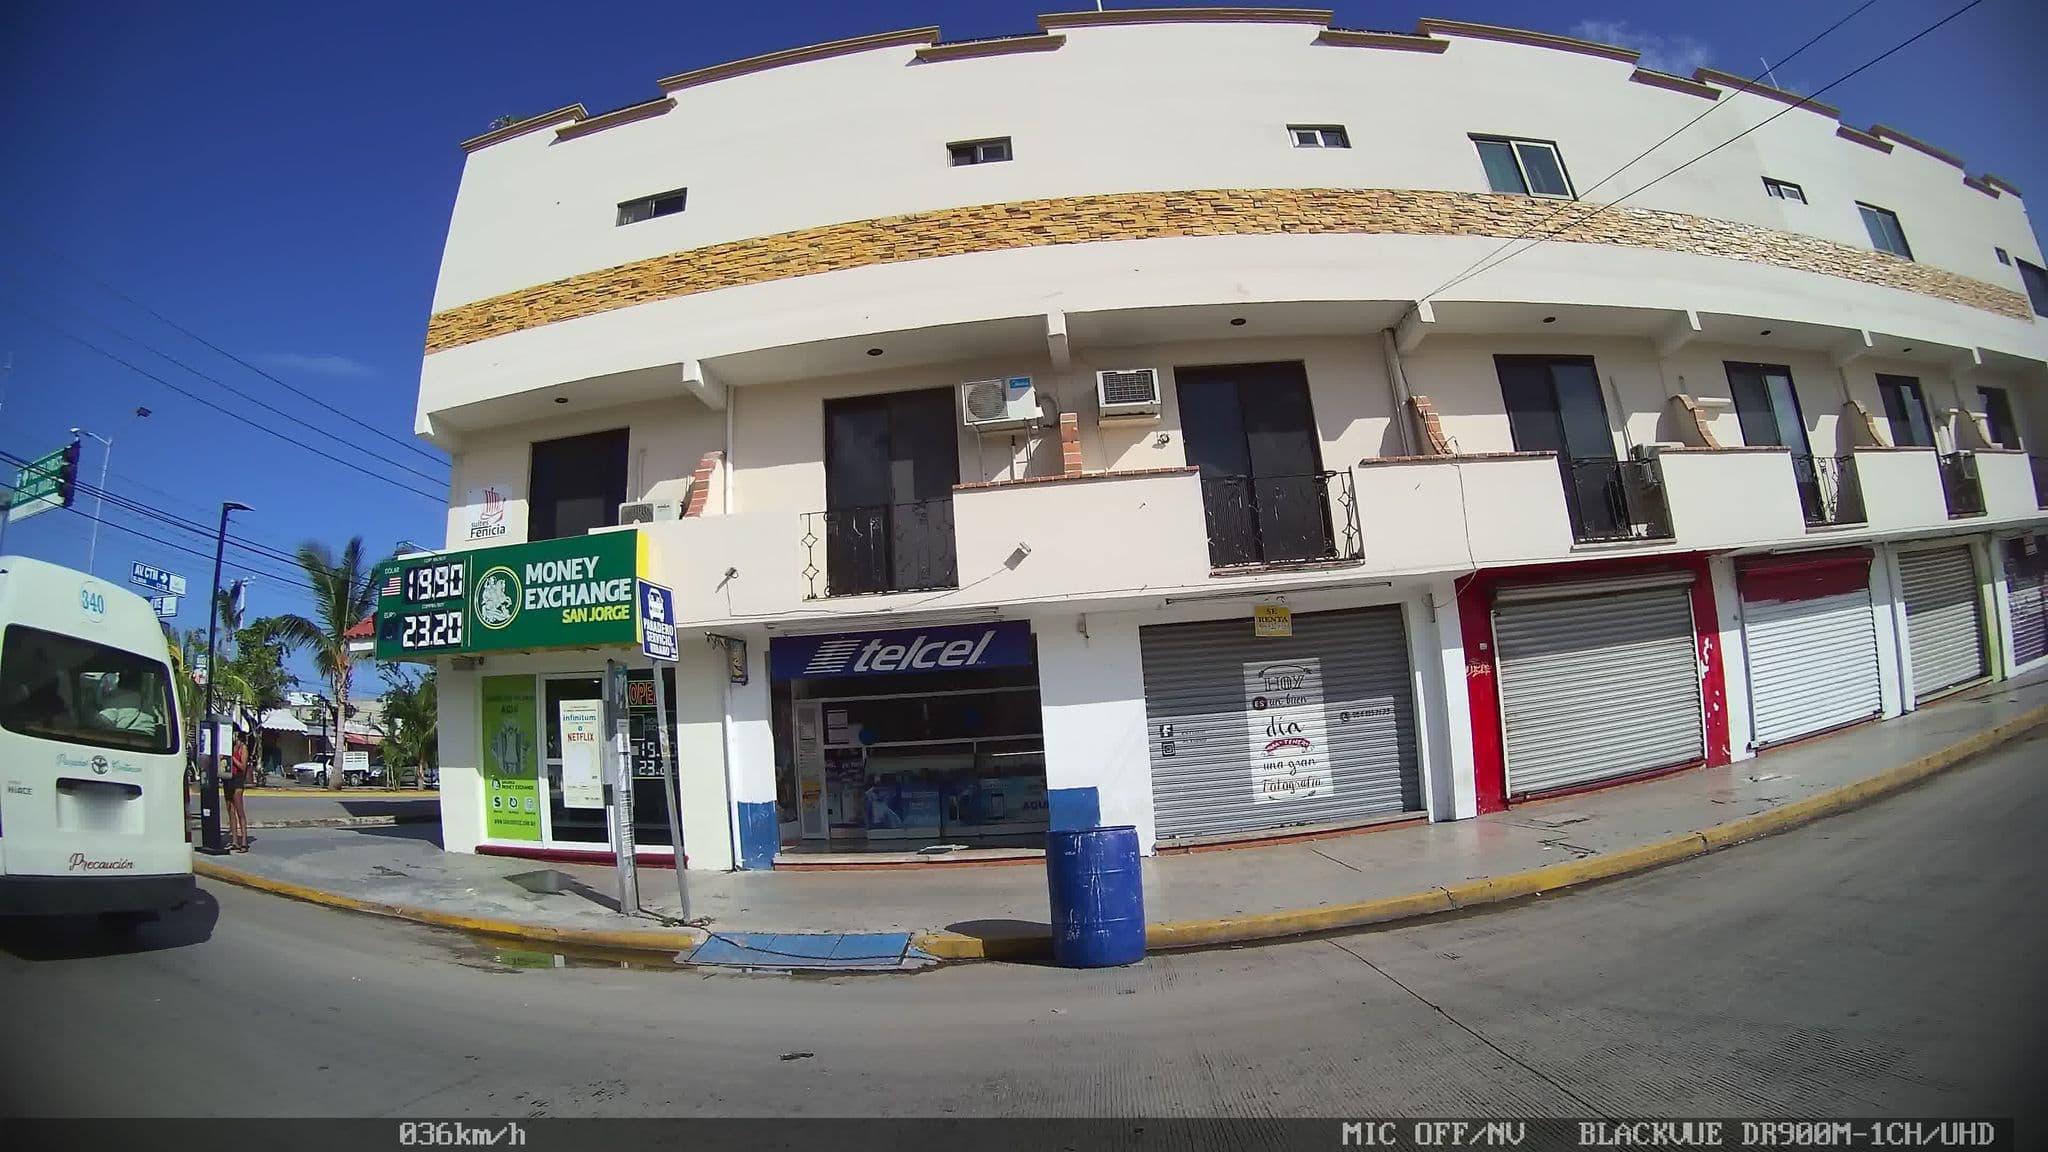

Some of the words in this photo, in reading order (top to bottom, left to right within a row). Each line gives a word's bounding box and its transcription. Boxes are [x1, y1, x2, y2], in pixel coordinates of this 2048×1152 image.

[470, 523, 505, 538] Fenicia
[408, 564, 464, 600] 19.90
[525, 556, 600, 585] MONEY
[82, 590, 104, 614] 340
[525, 578, 632, 610] EXCHANGE
[562, 607, 588, 624] SAN
[588, 605, 630, 622] JORGE
[402, 612, 462, 648] 23.20
[853, 630, 997, 674] telcel
[629, 682, 657, 704] OPE
[567, 733, 595, 742] NETFLIX
